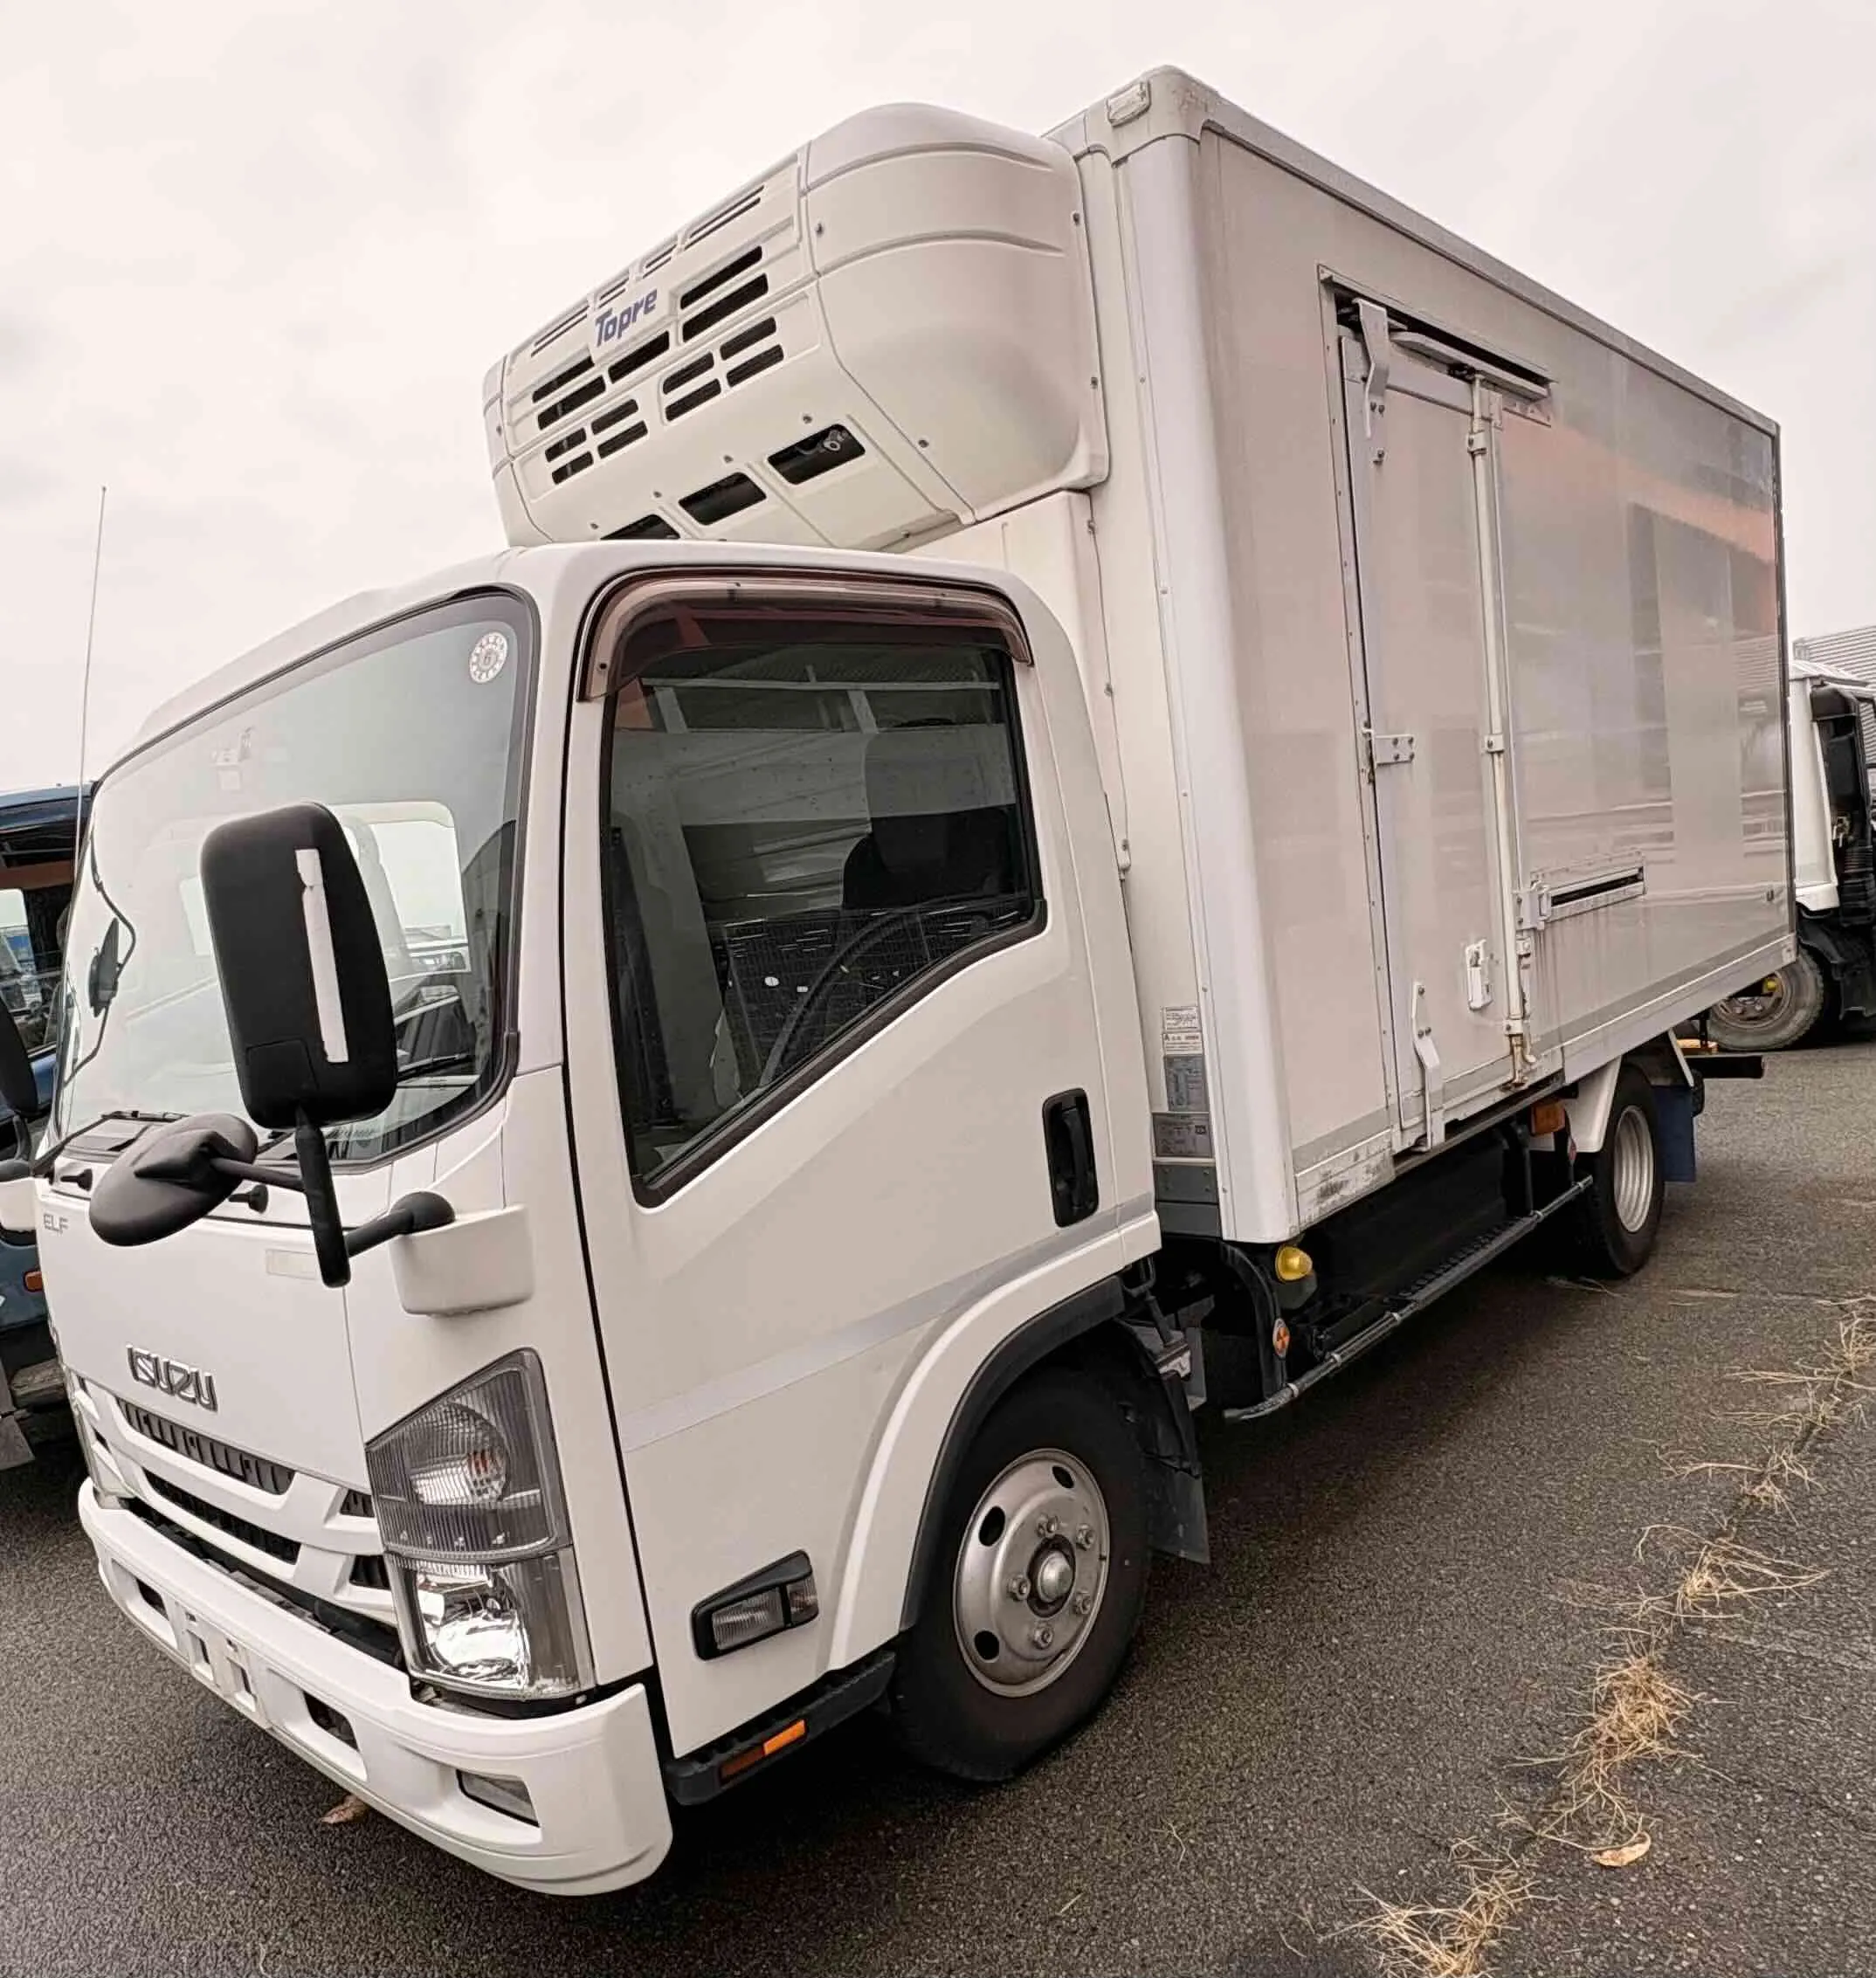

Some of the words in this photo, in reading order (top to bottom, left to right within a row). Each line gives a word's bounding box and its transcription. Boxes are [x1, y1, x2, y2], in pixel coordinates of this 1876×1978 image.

[595, 288, 658, 348] Topre
[44, 1213, 69, 1235] ELF
[126, 1343, 218, 1413] ISUZU
